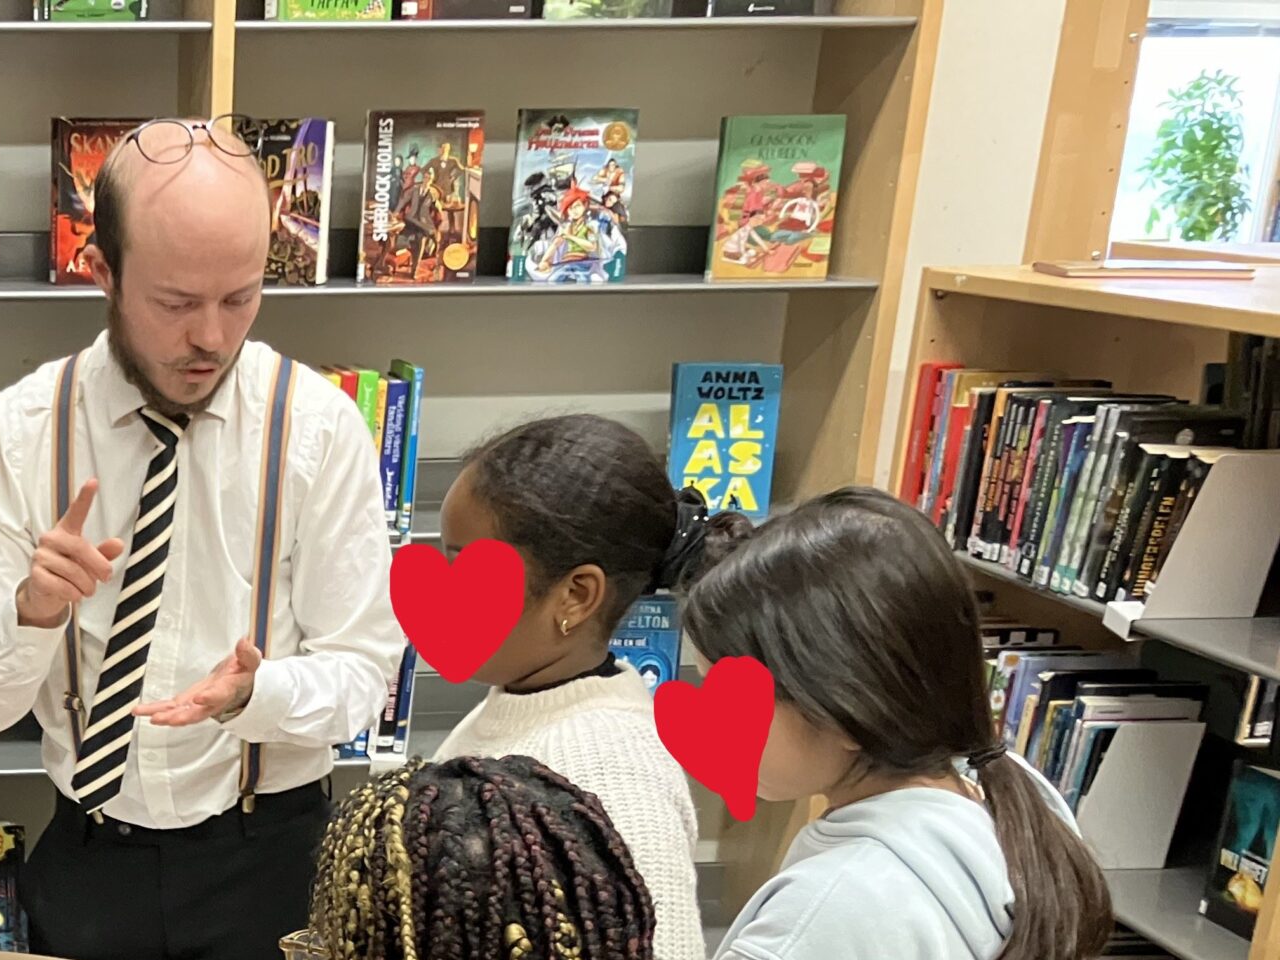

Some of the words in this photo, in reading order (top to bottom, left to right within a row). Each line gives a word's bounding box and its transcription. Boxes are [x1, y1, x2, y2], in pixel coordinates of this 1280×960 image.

[381, 117, 394, 173] HOLMES
[372, 174, 391, 242] SHERLOCK
[697, 387, 765, 401] WOLTZ
[701, 371, 760, 384] ANNA
